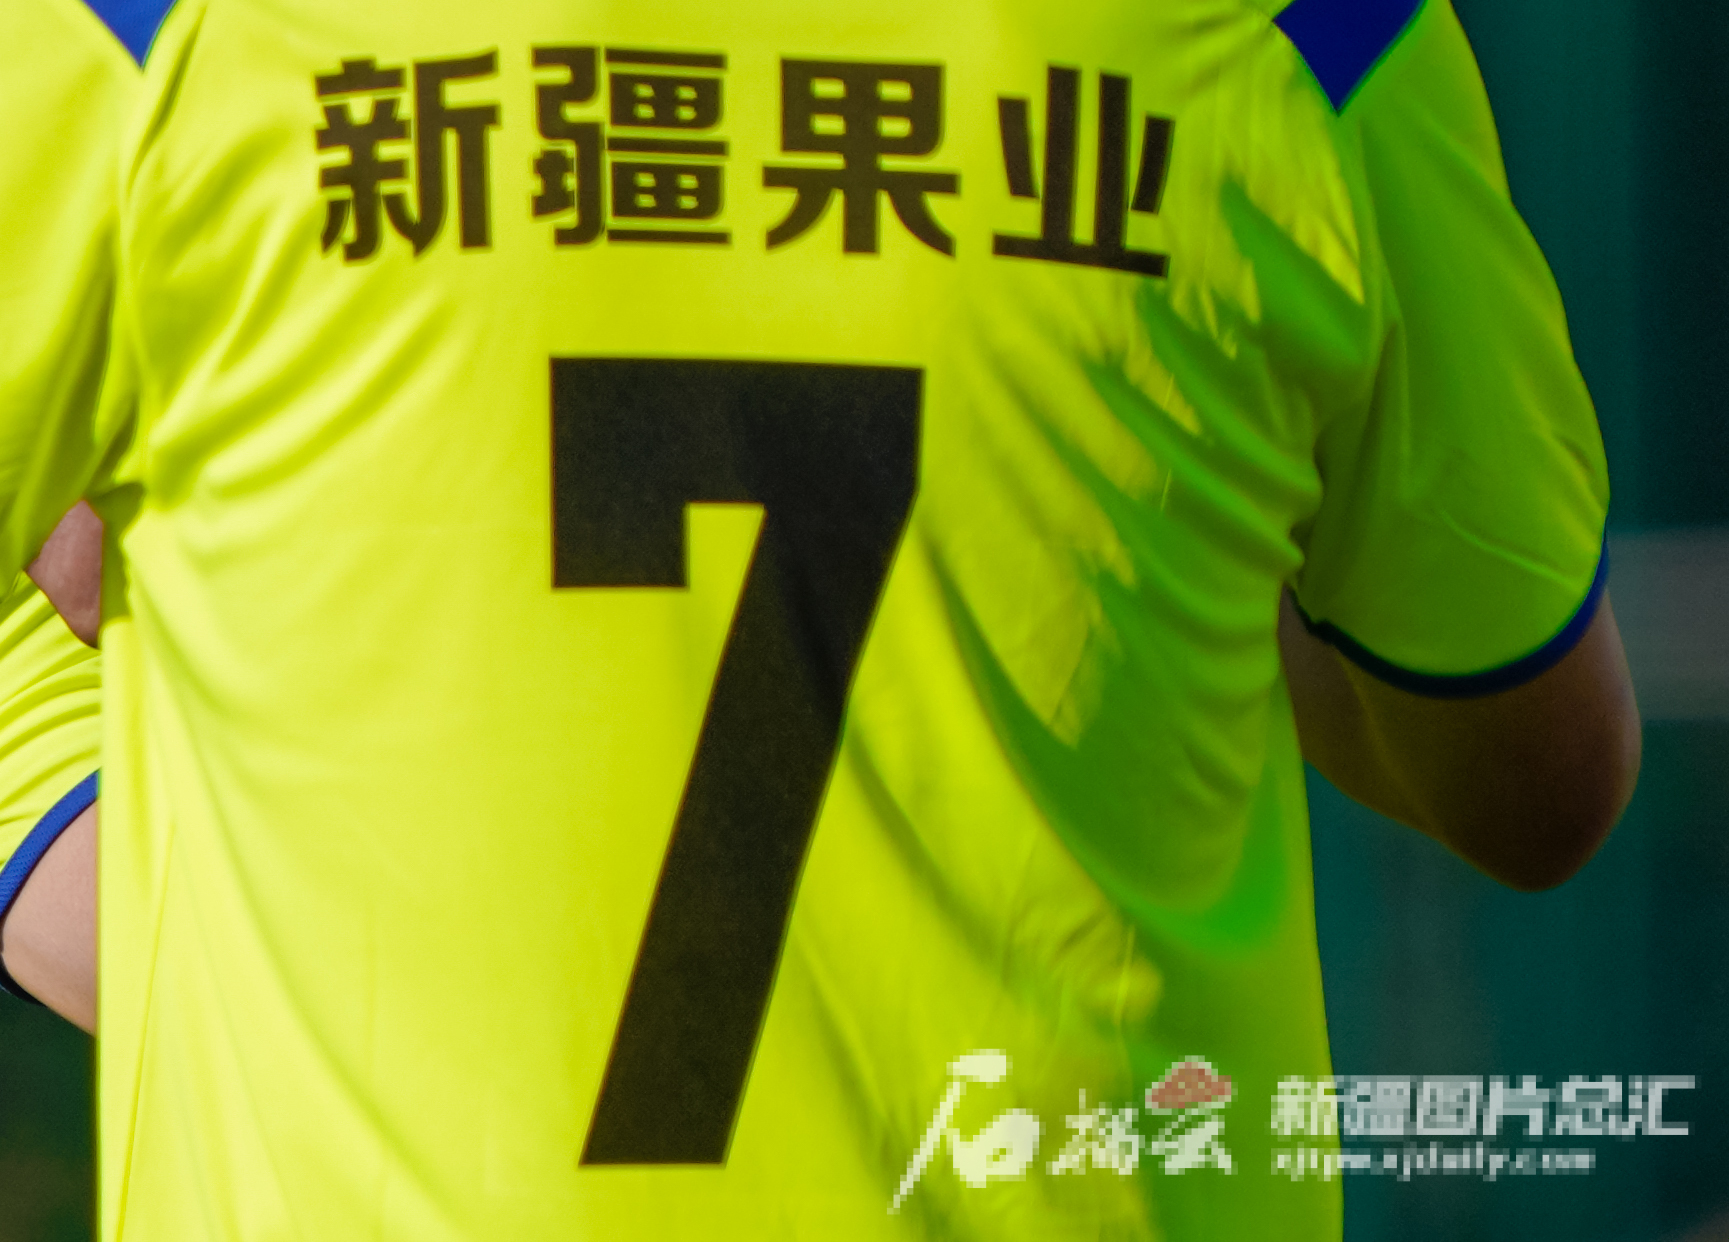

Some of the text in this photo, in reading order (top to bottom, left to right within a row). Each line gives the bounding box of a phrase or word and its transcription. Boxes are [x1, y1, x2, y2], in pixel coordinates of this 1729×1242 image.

[313, 44, 1176, 279] 新疆果业
[549, 354, 926, 1169] 7
